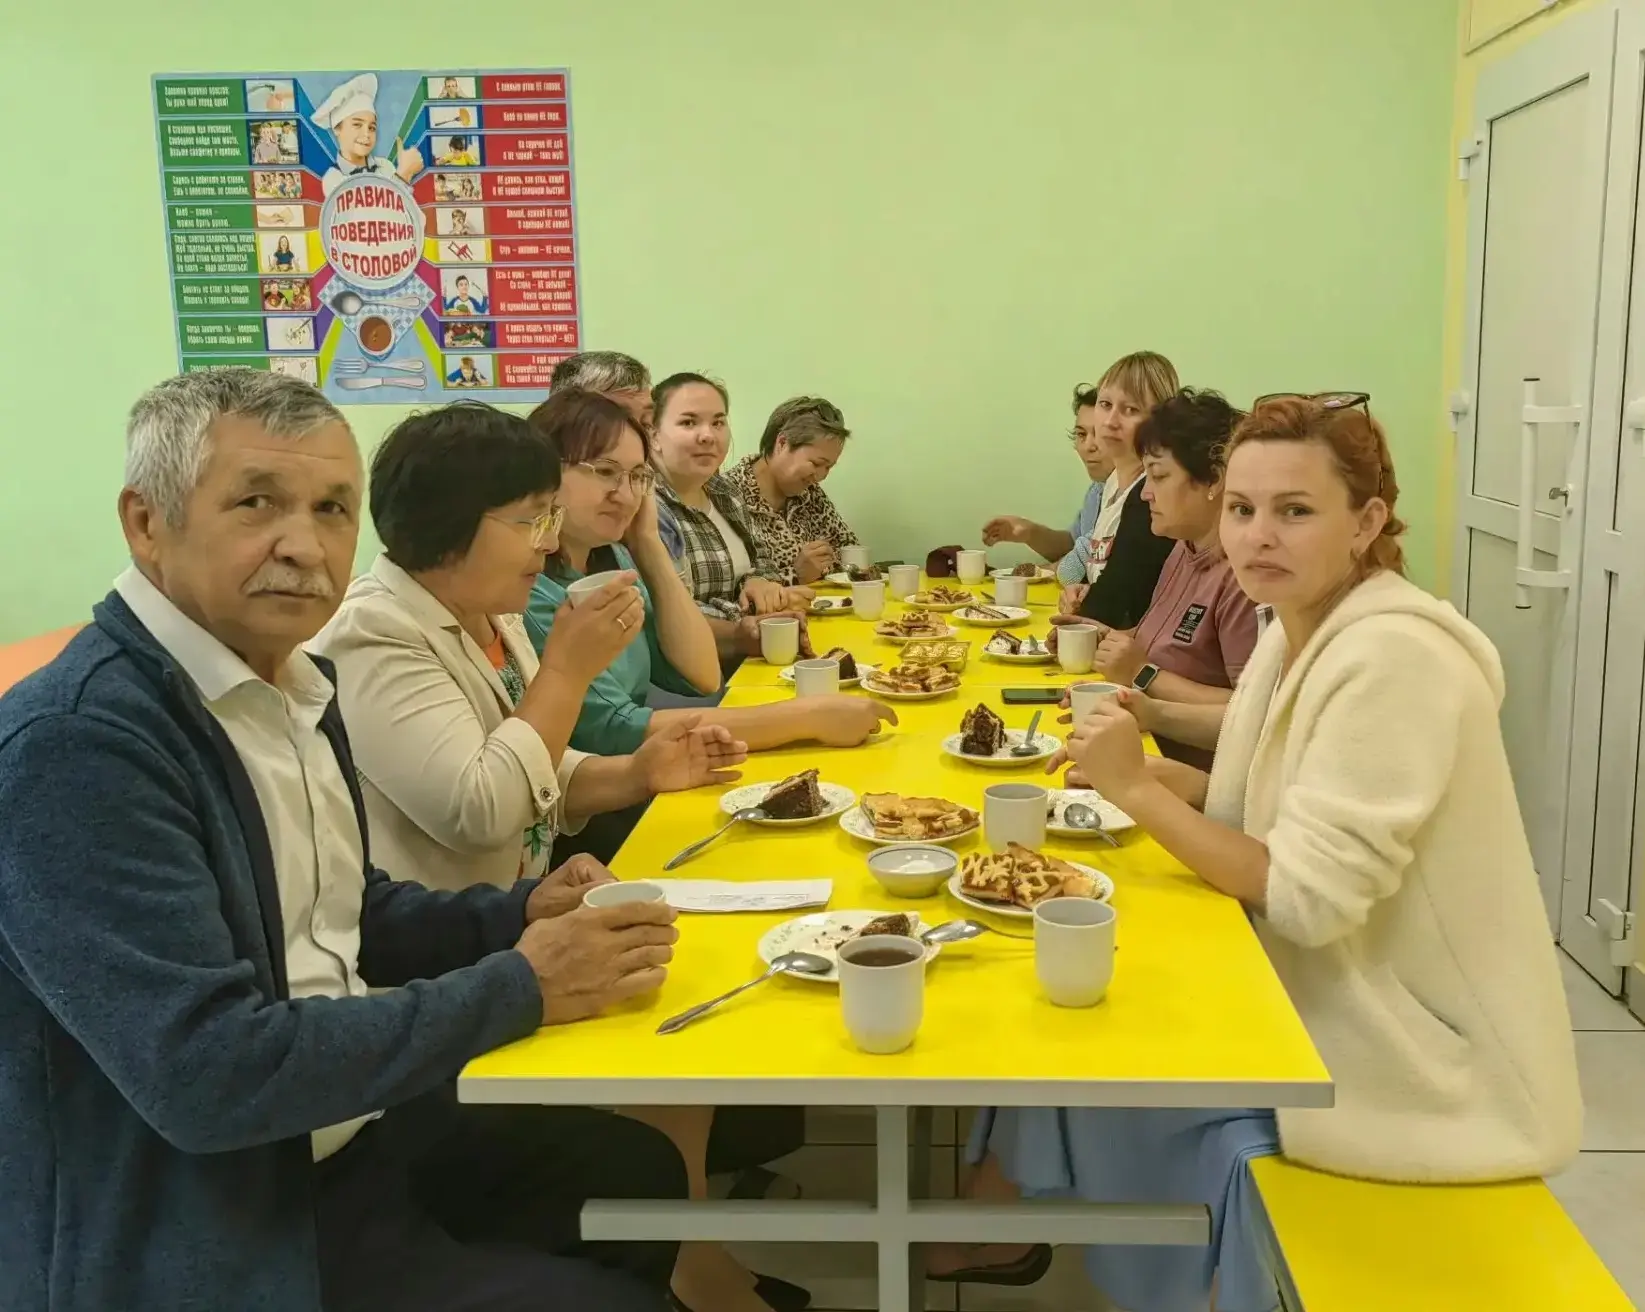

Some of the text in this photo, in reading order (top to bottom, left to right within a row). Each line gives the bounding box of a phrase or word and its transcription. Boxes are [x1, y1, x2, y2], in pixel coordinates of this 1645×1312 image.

[336, 185, 406, 214] ПРАВИЛА
[330, 220, 414, 246] ПОВЕДЕНИЯ
[330, 244, 417, 276] В СТОЛОВОЙ
